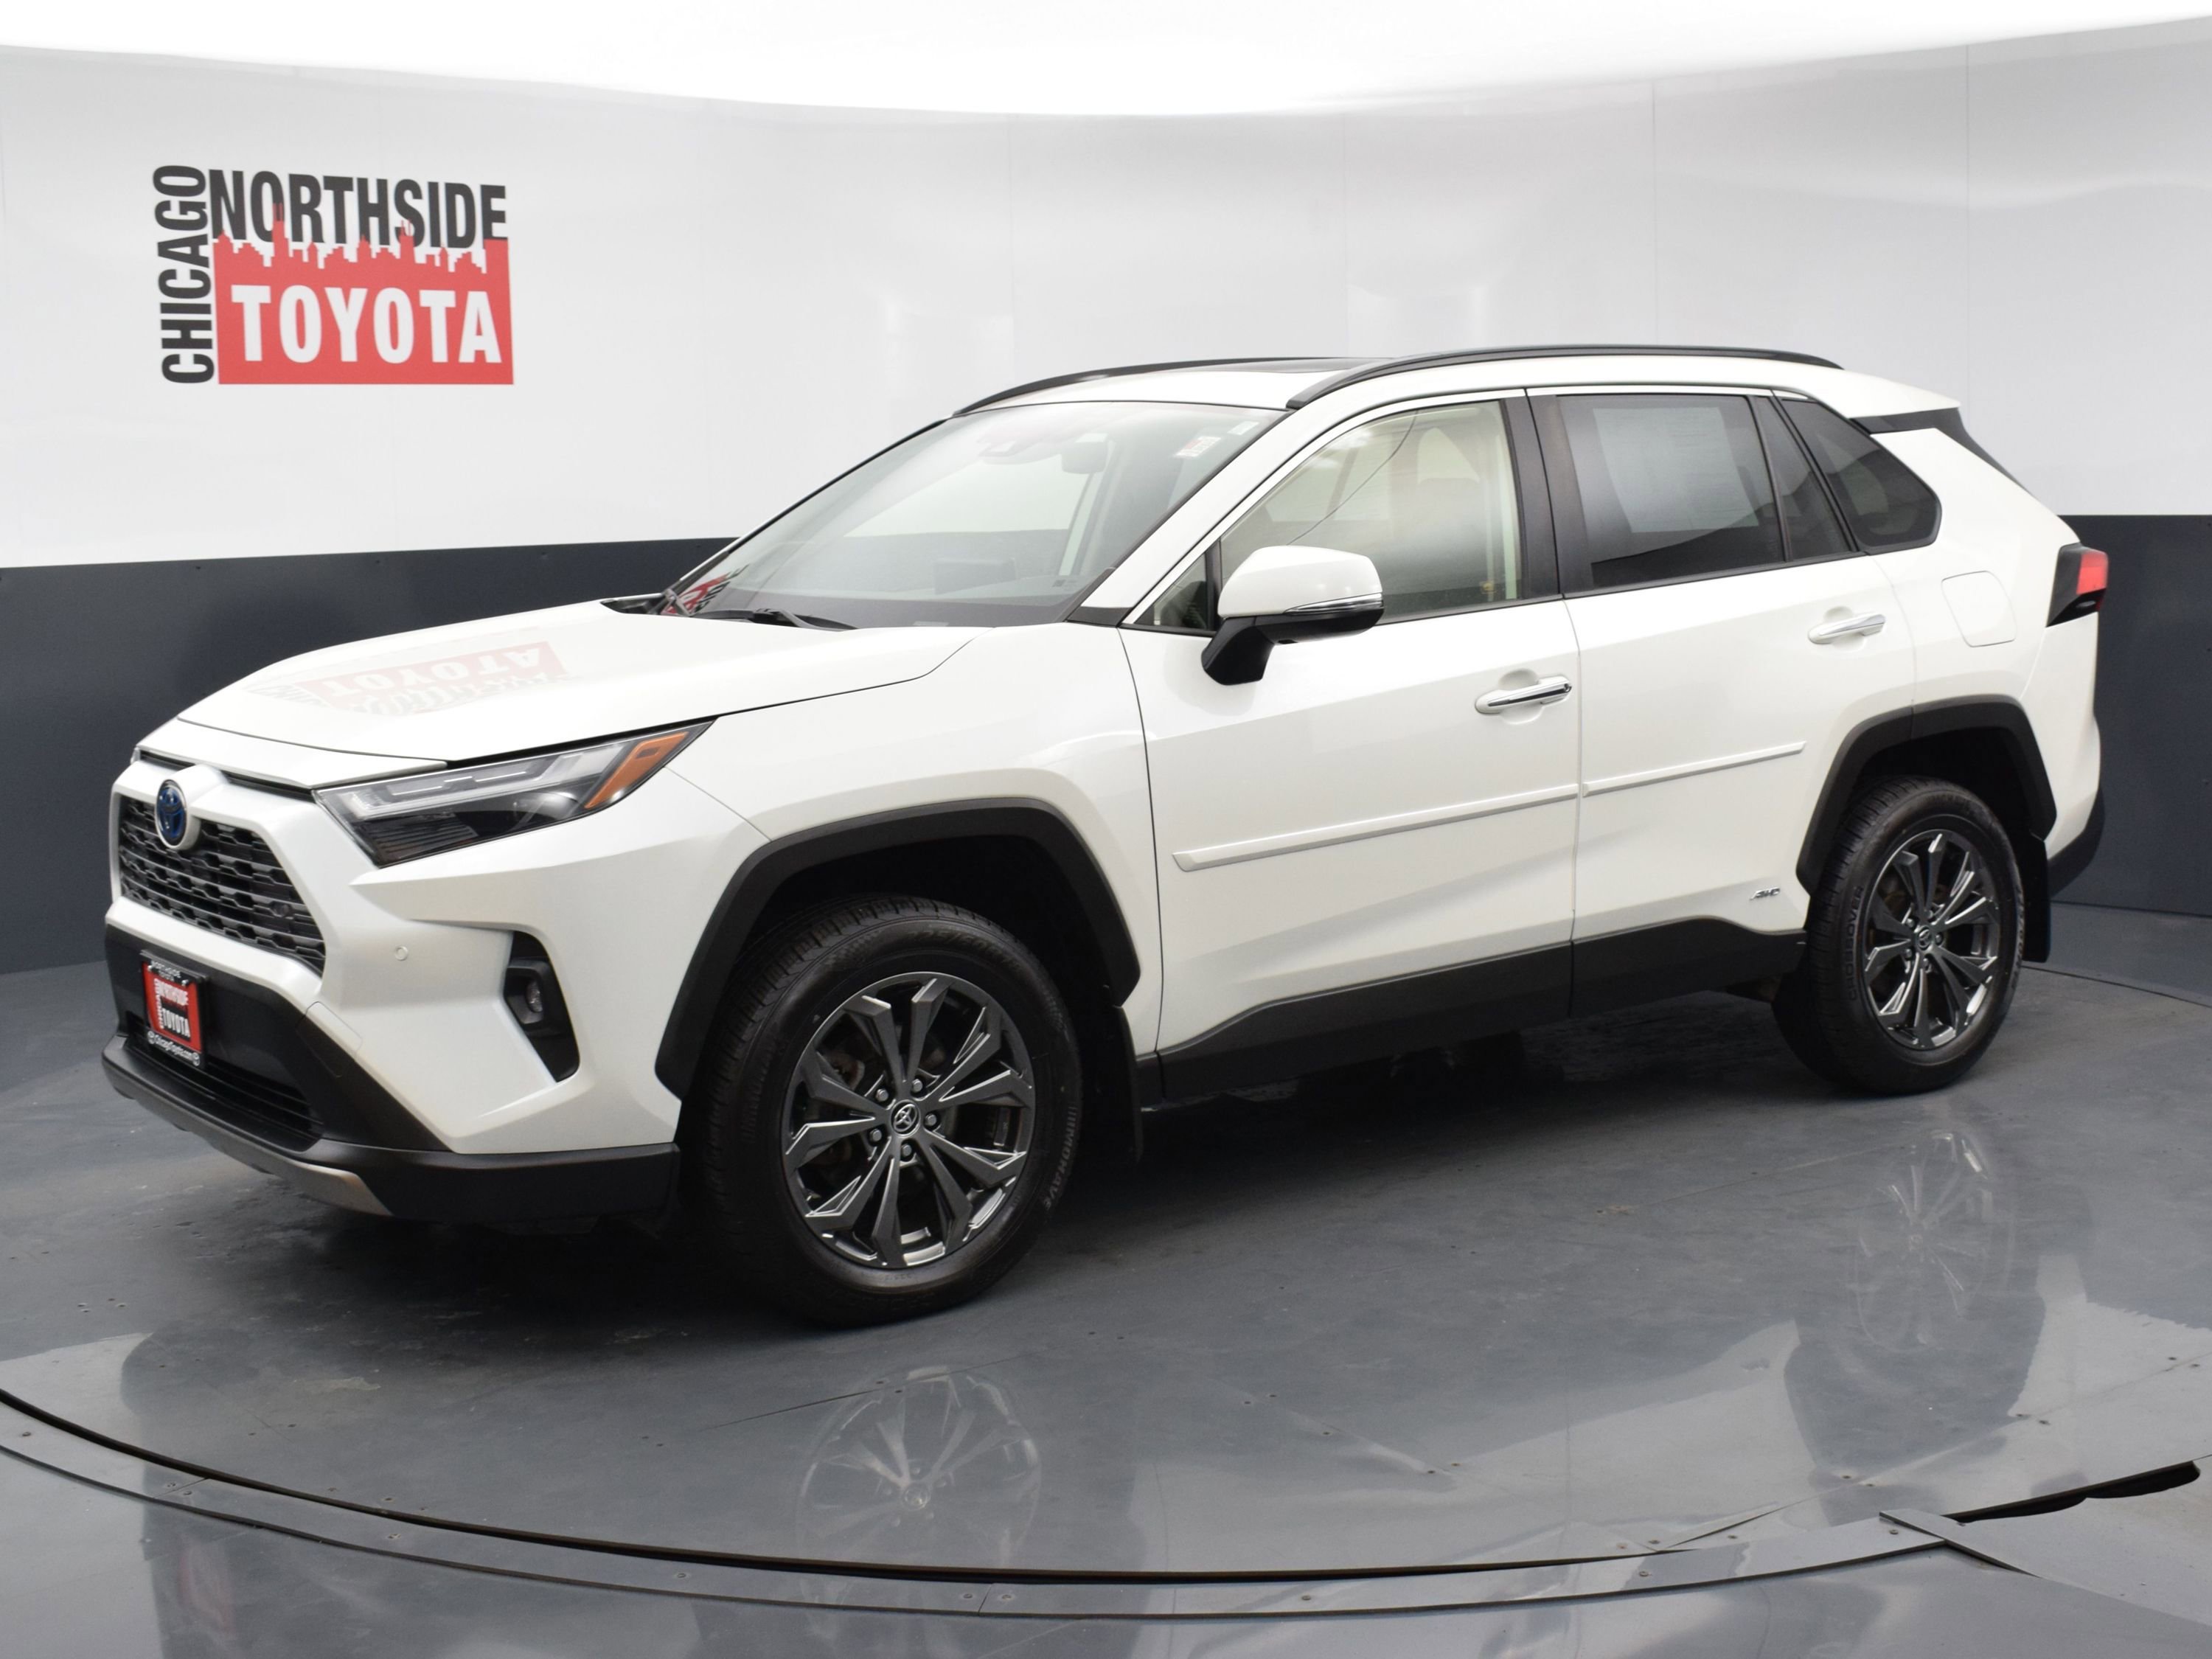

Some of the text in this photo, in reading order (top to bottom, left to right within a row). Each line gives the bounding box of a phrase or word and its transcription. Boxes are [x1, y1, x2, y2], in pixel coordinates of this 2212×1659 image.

[209, 169, 508, 248] NORTHSIDE
[153, 165, 214, 383] CHICAGO
[231, 285, 502, 364] TOYOTA
